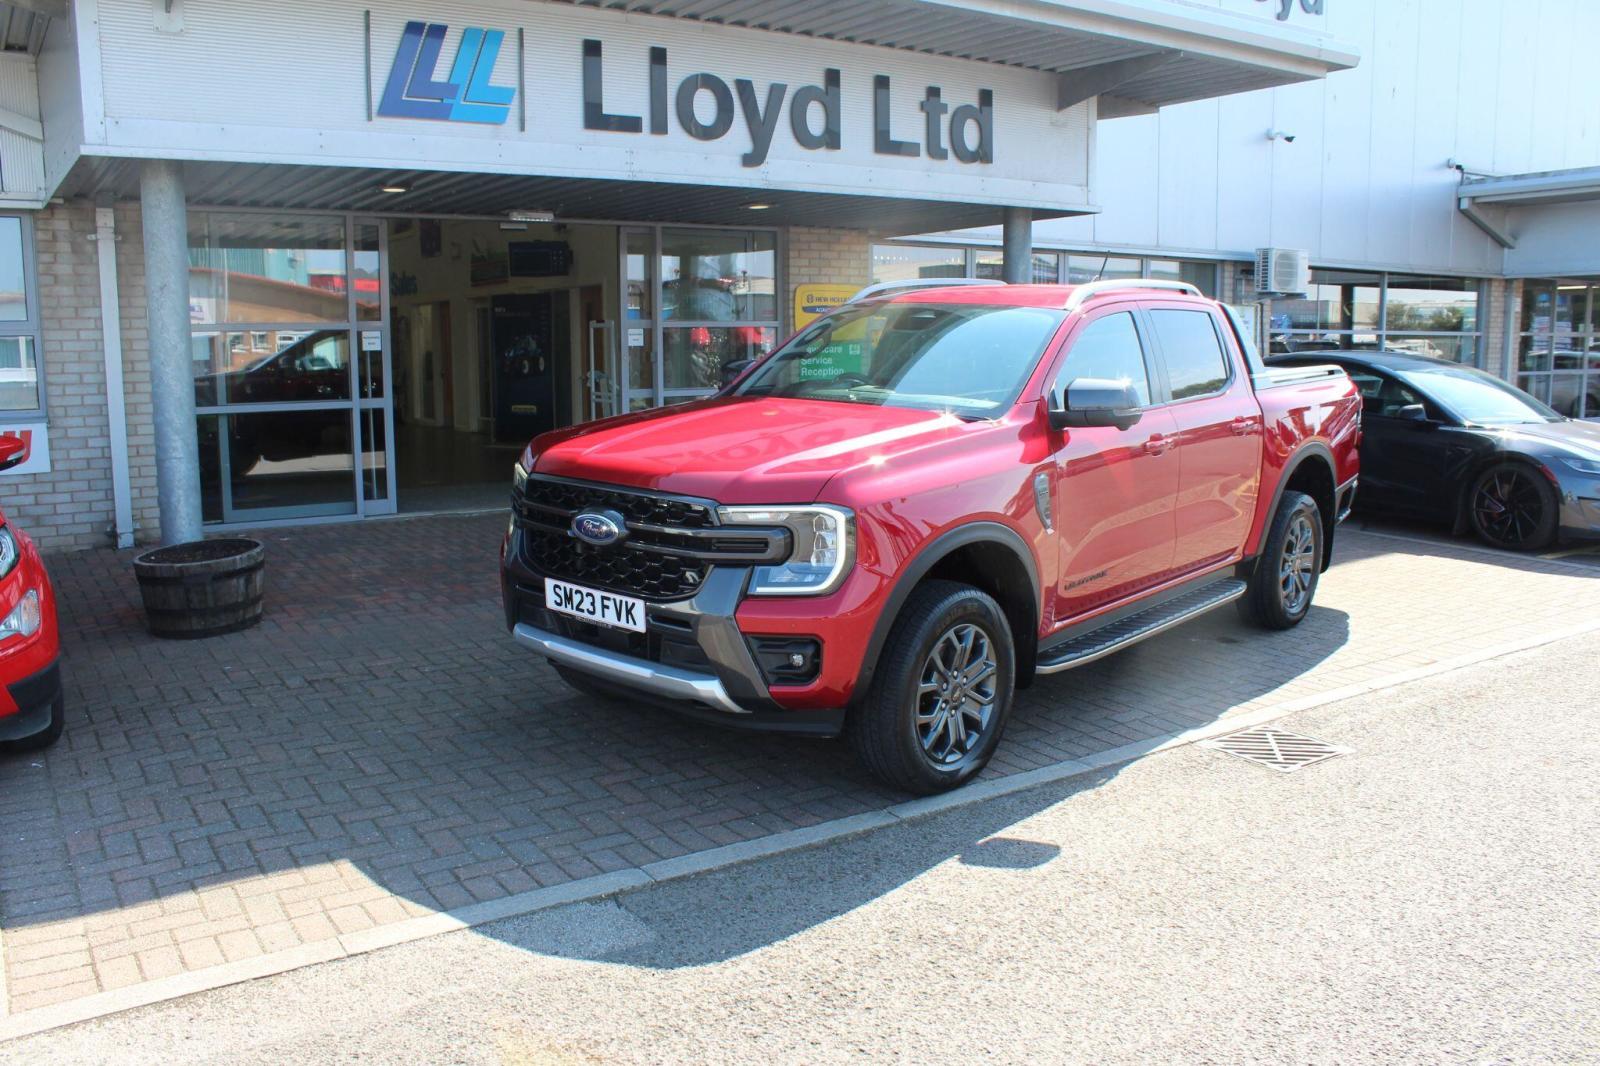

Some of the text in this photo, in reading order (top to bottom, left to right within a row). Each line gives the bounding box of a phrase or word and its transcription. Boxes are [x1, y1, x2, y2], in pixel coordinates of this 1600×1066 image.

[583, 38, 993, 167] Lloyd Ltd
[801, 357, 833, 366] Service
[801, 366, 844, 377] Reception
[581, 518, 611, 538] Ford
[552, 584, 596, 616] SM23
[600, 595, 637, 626] FVK
